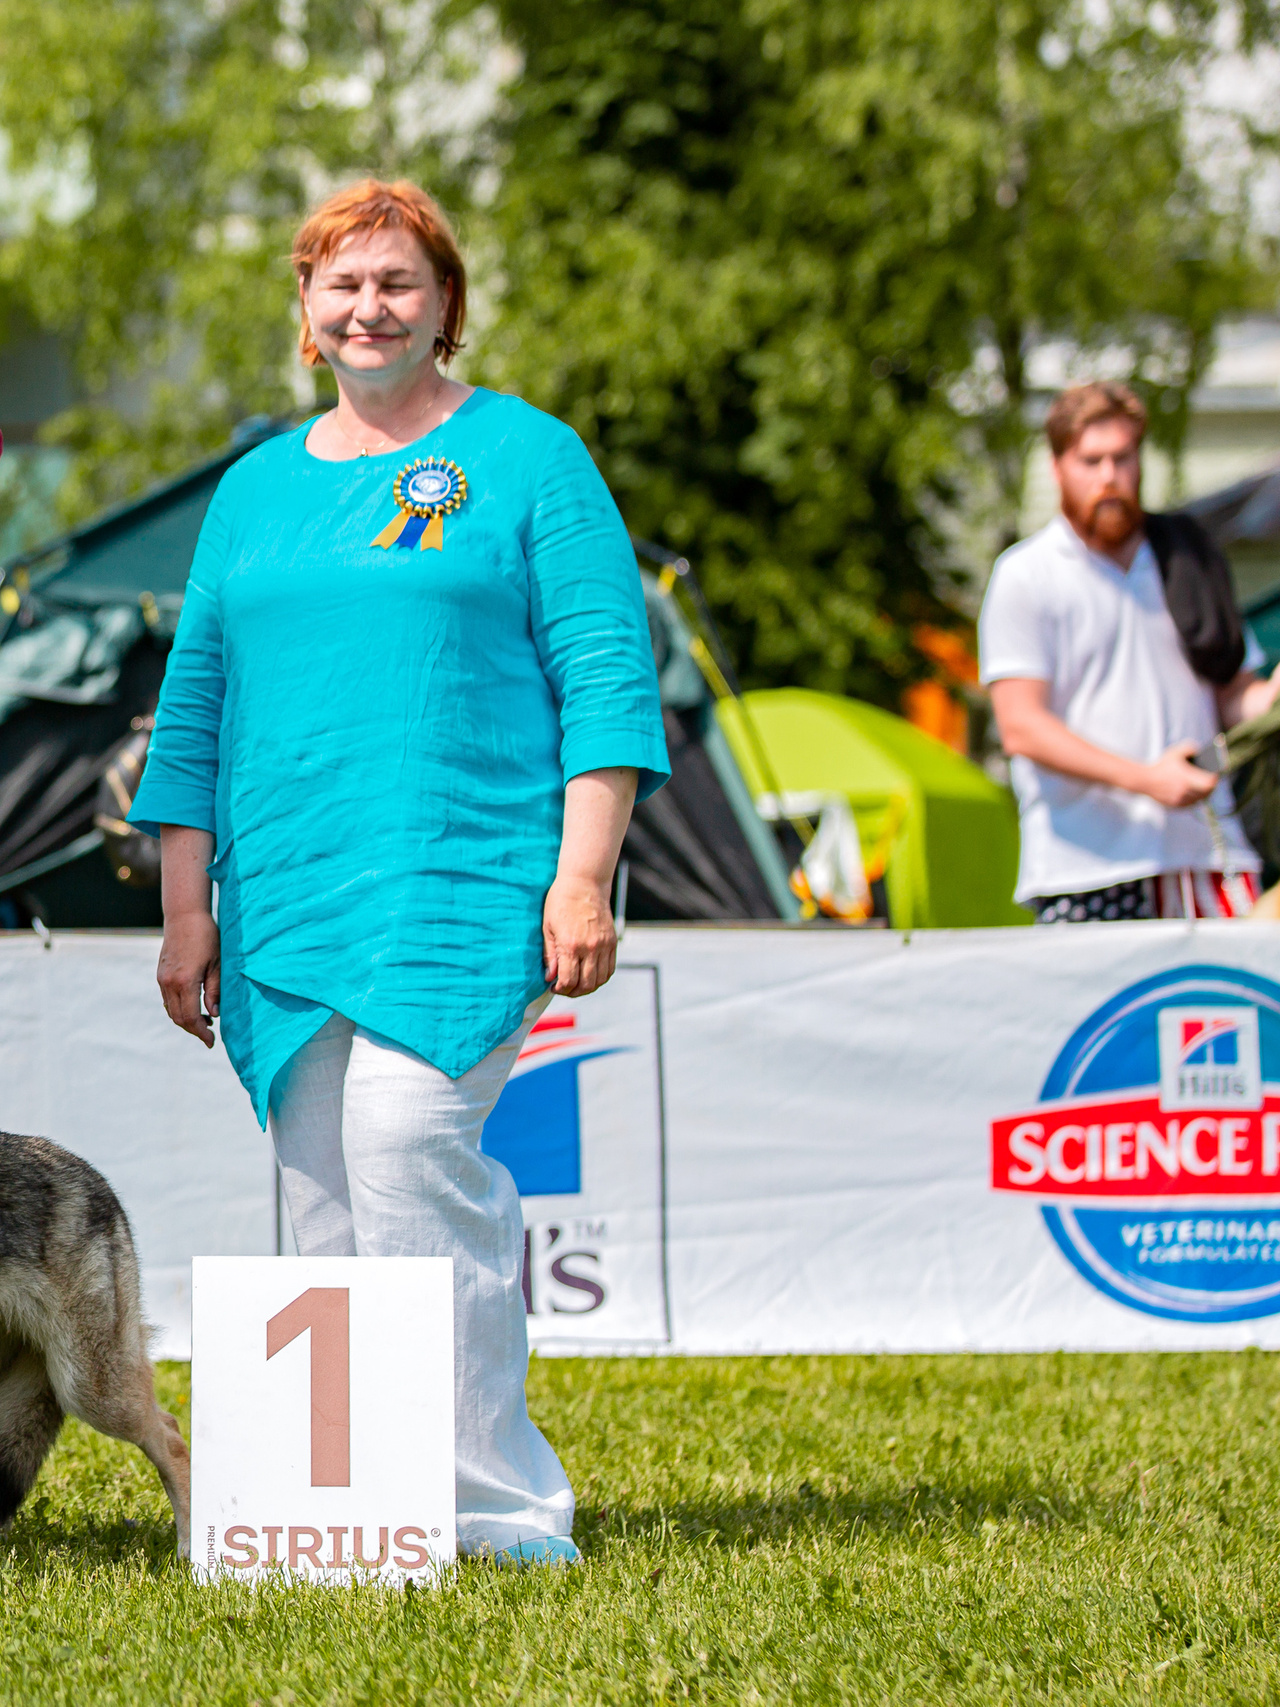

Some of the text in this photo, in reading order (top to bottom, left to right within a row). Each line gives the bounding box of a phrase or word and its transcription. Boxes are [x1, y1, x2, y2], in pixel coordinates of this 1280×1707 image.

[1008, 1116, 1254, 1185] SCIENCE
[267, 1287, 350, 1487] 1
[223, 1525, 429, 1570] SIRIUS
